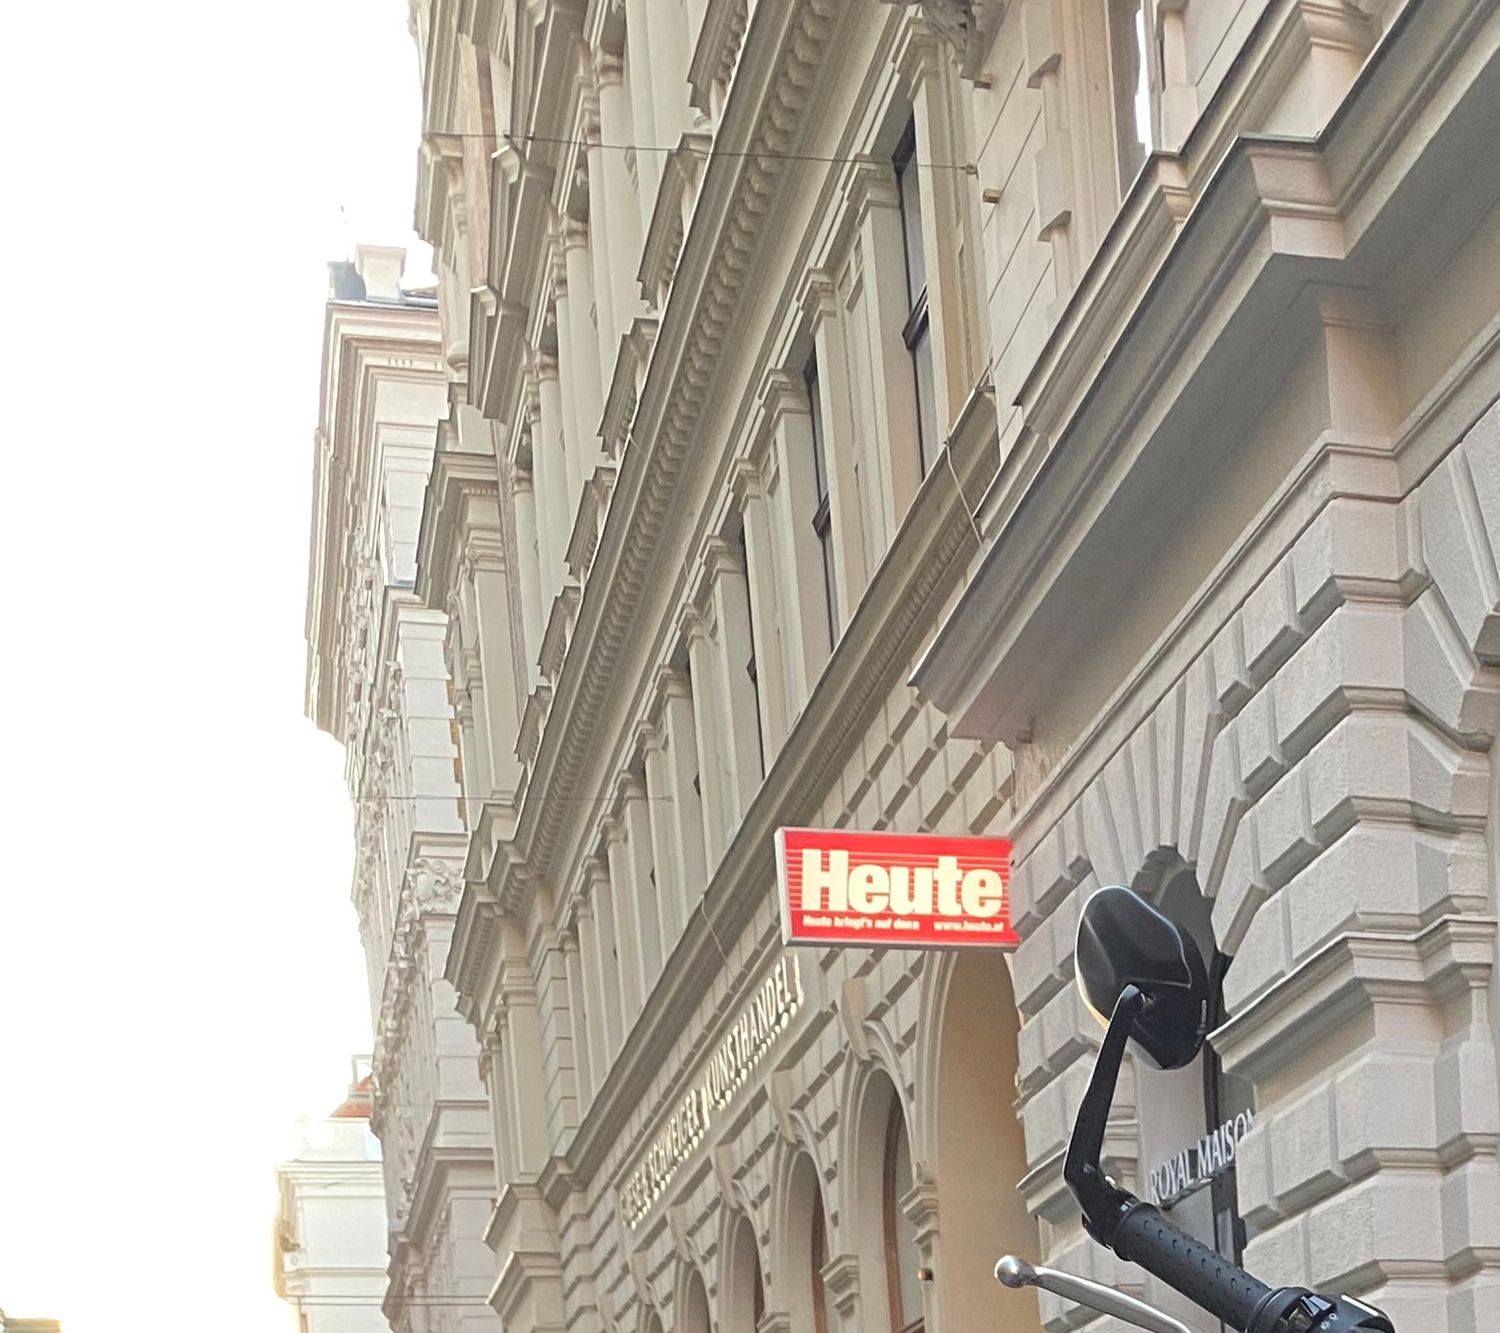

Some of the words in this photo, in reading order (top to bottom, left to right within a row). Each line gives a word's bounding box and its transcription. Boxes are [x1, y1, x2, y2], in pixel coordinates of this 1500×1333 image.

[801, 848, 1003, 918] Heute
[803, 914, 833, 927] Heute
[934, 920, 1004, 933] www.heute.at
[648, 1088, 701, 1192] SCHWEIGER
[704, 956, 792, 1111] KUNSTHANDEL
[1151, 1148, 1194, 1205] ROYAL
